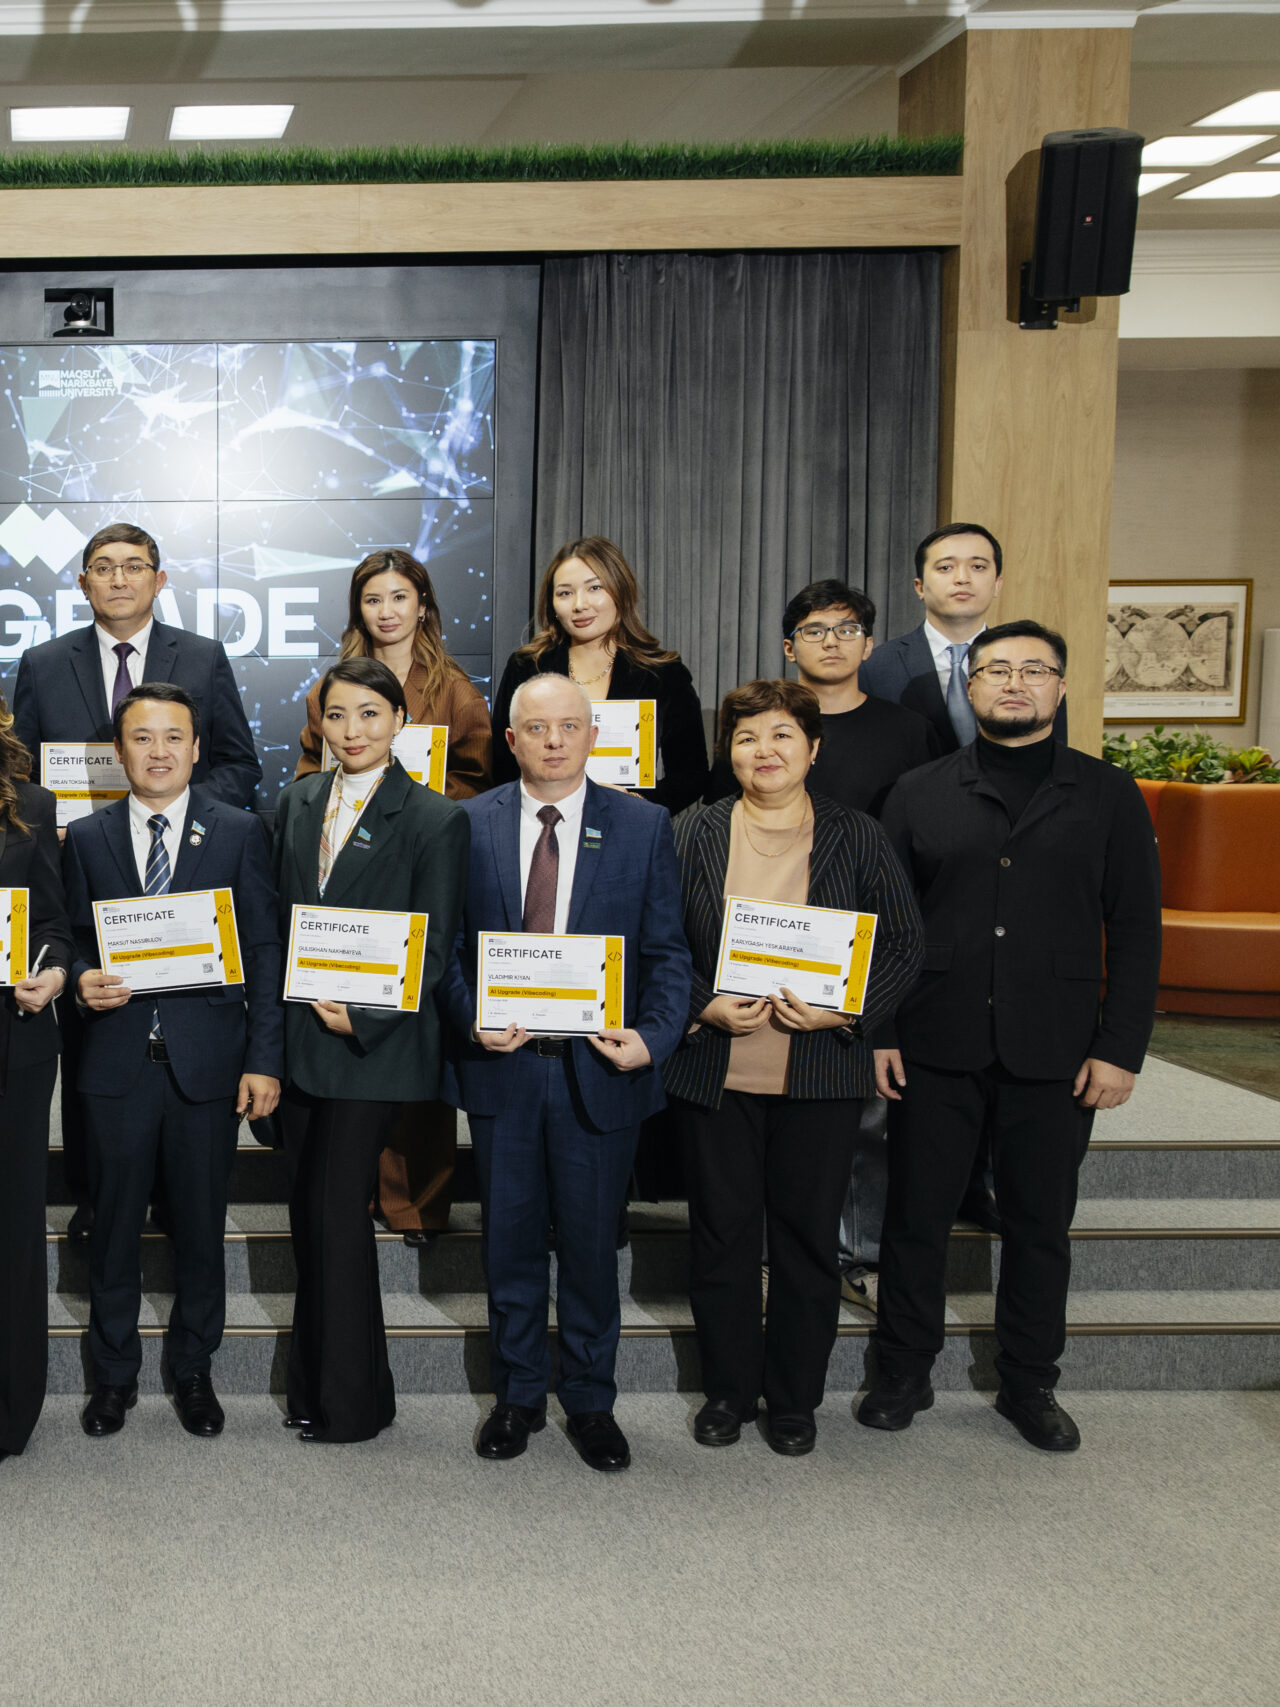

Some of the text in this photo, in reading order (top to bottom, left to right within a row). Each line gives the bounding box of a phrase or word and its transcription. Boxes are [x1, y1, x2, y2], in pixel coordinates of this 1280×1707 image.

[60, 370, 101, 379] MAQSUT
[60, 388, 116, 397] UNIVERSITY
[50, 756, 112, 765] CERTIFICATE
[104, 910, 175, 925] CERTIFICATE
[735, 913, 811, 931] CERTIFICATE
[300, 921, 369, 934] CERTIFICATE
[488, 948, 562, 959] CERTIFICATE
[740, 954, 762, 962] Upgrade
